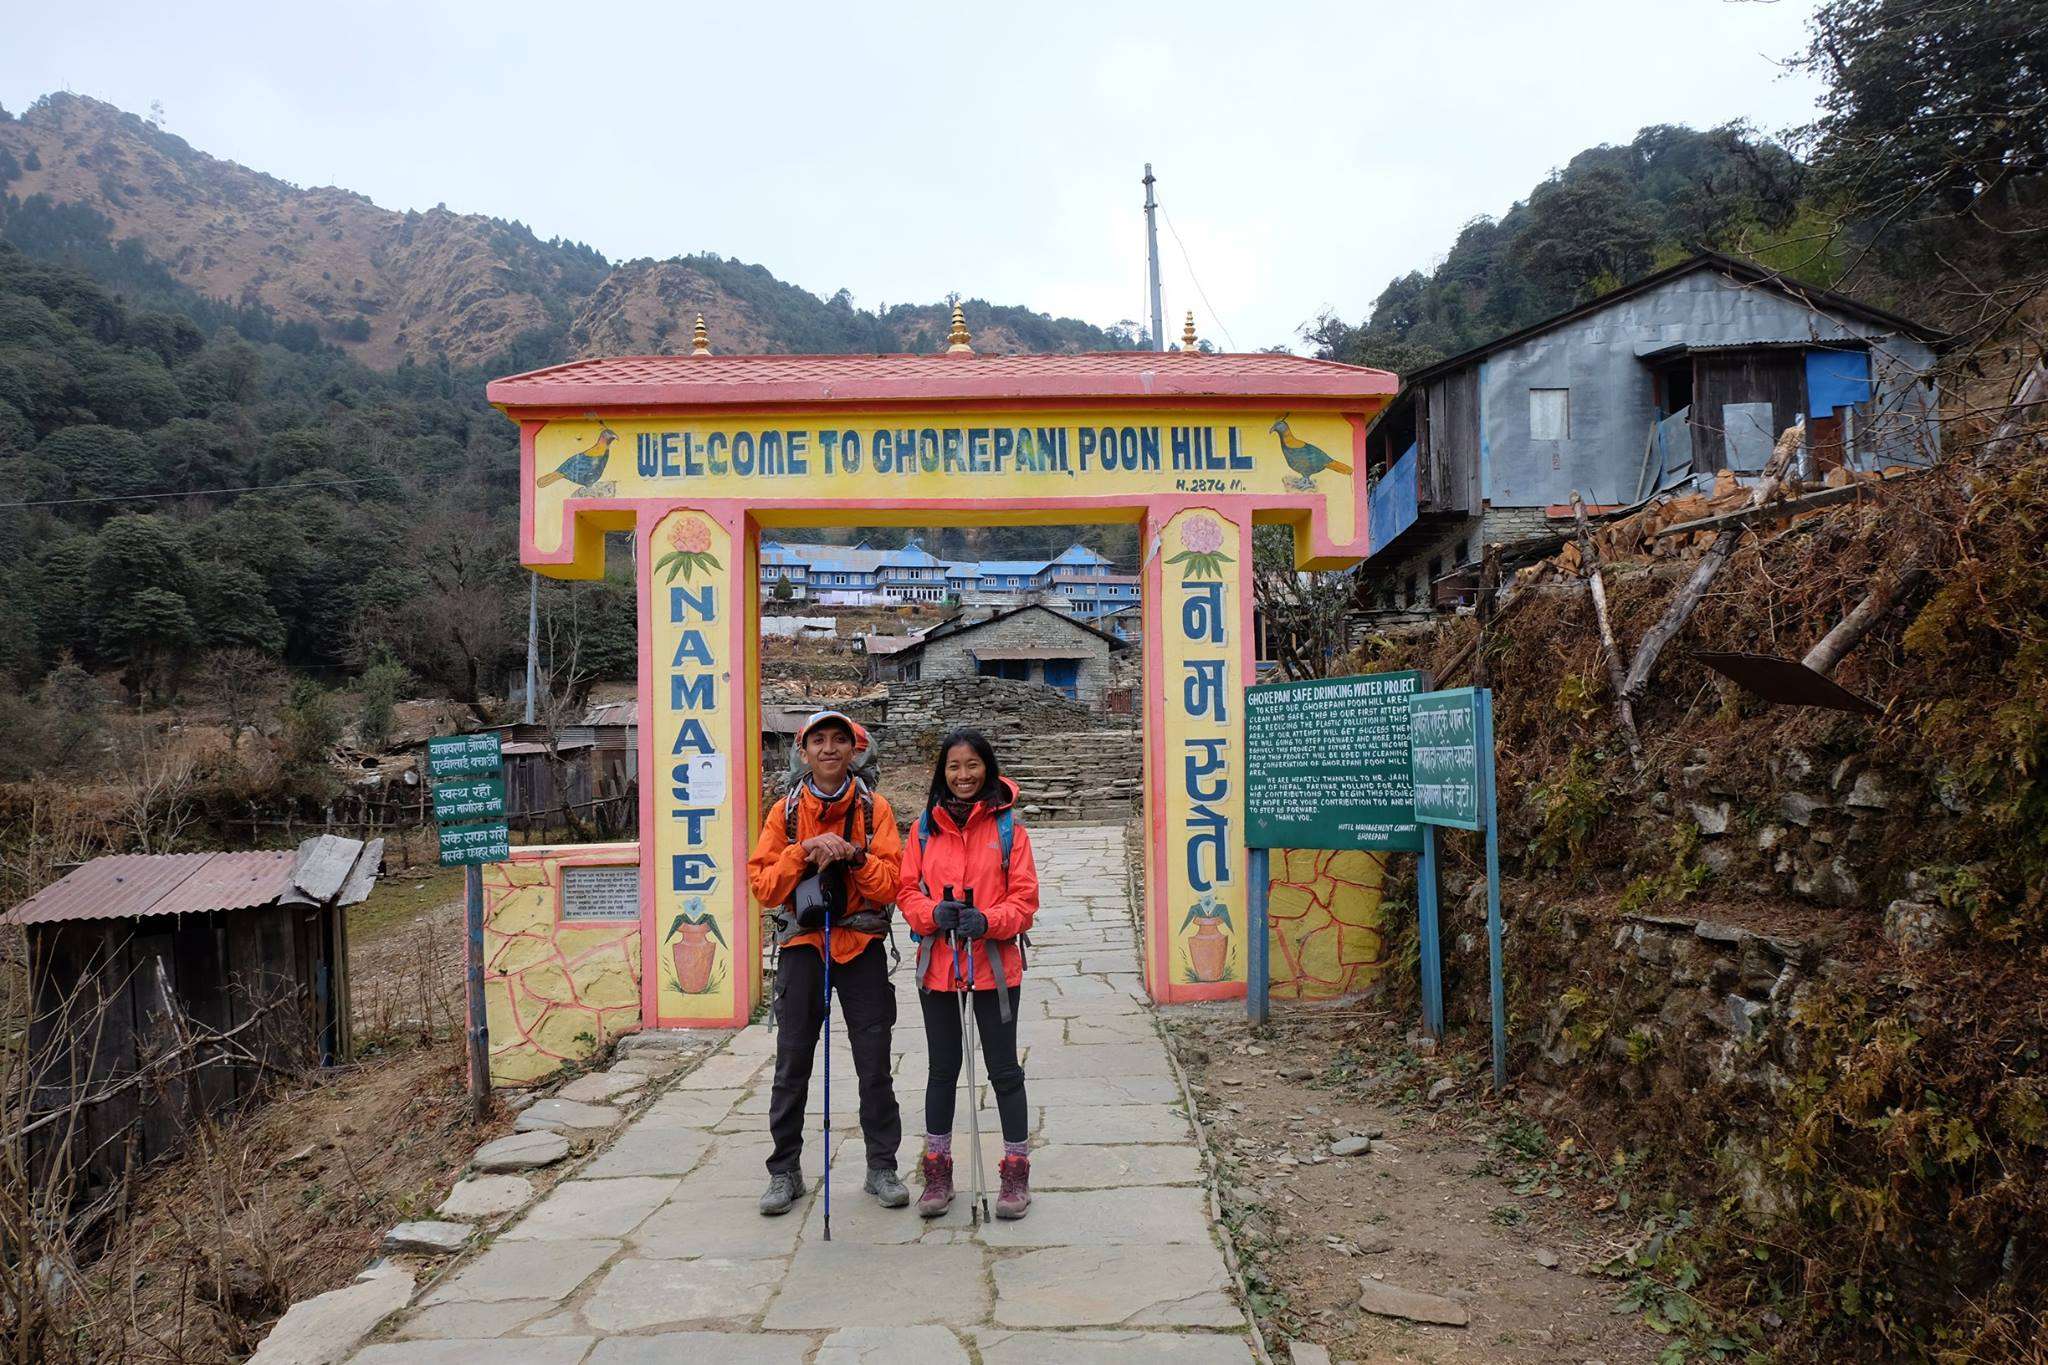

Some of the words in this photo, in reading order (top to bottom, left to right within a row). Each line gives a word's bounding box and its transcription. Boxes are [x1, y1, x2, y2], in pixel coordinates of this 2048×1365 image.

[818, 428, 863, 475] TO
[871, 426, 1075, 479] GHOREPANI,
[1078, 425, 1161, 472] POON
[1169, 425, 1253, 471] HILL
[1248, 690, 1291, 706] GHOREPANI
[1292, 687, 1313, 702] SAFE
[1314, 684, 1353, 701] DRINKING
[1354, 681, 1383, 697] WATER
[1384, 678, 1415, 694] PROJECT
[1256, 706, 1264, 714] TO
[1265, 705, 1283, 714] KEEP
[1286, 704, 1300, 712] OUR
[1302, 700, 1346, 711] GHOREPANI
[1347, 698, 1367, 707] POON
[1368, 697, 1384, 706] HILL
[1386, 696, 1408, 704] AREA
[1250, 716, 1271, 724] CLEAN
[1310, 711, 1328, 720] THIS
[1340, 710, 1356, 718] OUR
[1358, 708, 1378, 717] FIRST
[1249, 724, 1262, 732] FOR
[1265, 722, 1298, 731] REDUCING
[1300, 720, 1313, 729] THE
[1316, 719, 1341, 728] PLASTIC
[1344, 716, 1379, 727] POLLUTION
[1389, 714, 1408, 723] THIS
[1278, 731, 1291, 739] OUR
[1292, 730, 1321, 738] ATTEMPT
[1323, 728, 1338, 736] WILL
[1341, 727, 1356, 736] GET
[1359, 725, 1389, 735] SUCCESS
[1276, 738, 1293, 746] GOING
[1305, 737, 1321, 745] STEP
[1324, 736, 1355, 744] FORWARD
[1372, 734, 1390, 742] MORE
[1341, 751, 1360, 759] USED
[1372, 750, 1408, 758] CLEANING
[1364, 758, 1385, 767] POON
[1360, 774, 1370, 782] TO
[1388, 773, 1409, 781] JAAN
[1342, 782, 1375, 790] HOLLAND
[1377, 782, 1393, 790] FOR
[439, 787, 469, 801] स्वस्थ
[1264, 790, 1322, 798] CONTRIBUTIONS
[1340, 790, 1365, 798] BEGIN
[1384, 790, 1414, 798] PROJEC
[1262, 798, 1281, 806] HOPE
[1320, 798, 1372, 807] CONTRIBUTION
[1372, 798, 1388, 806] TOO
[1391, 798, 1404, 806] AND
[1356, 824, 1394, 832] MANAGEMENT
[1358, 832, 1389, 841] GHOREPANI
